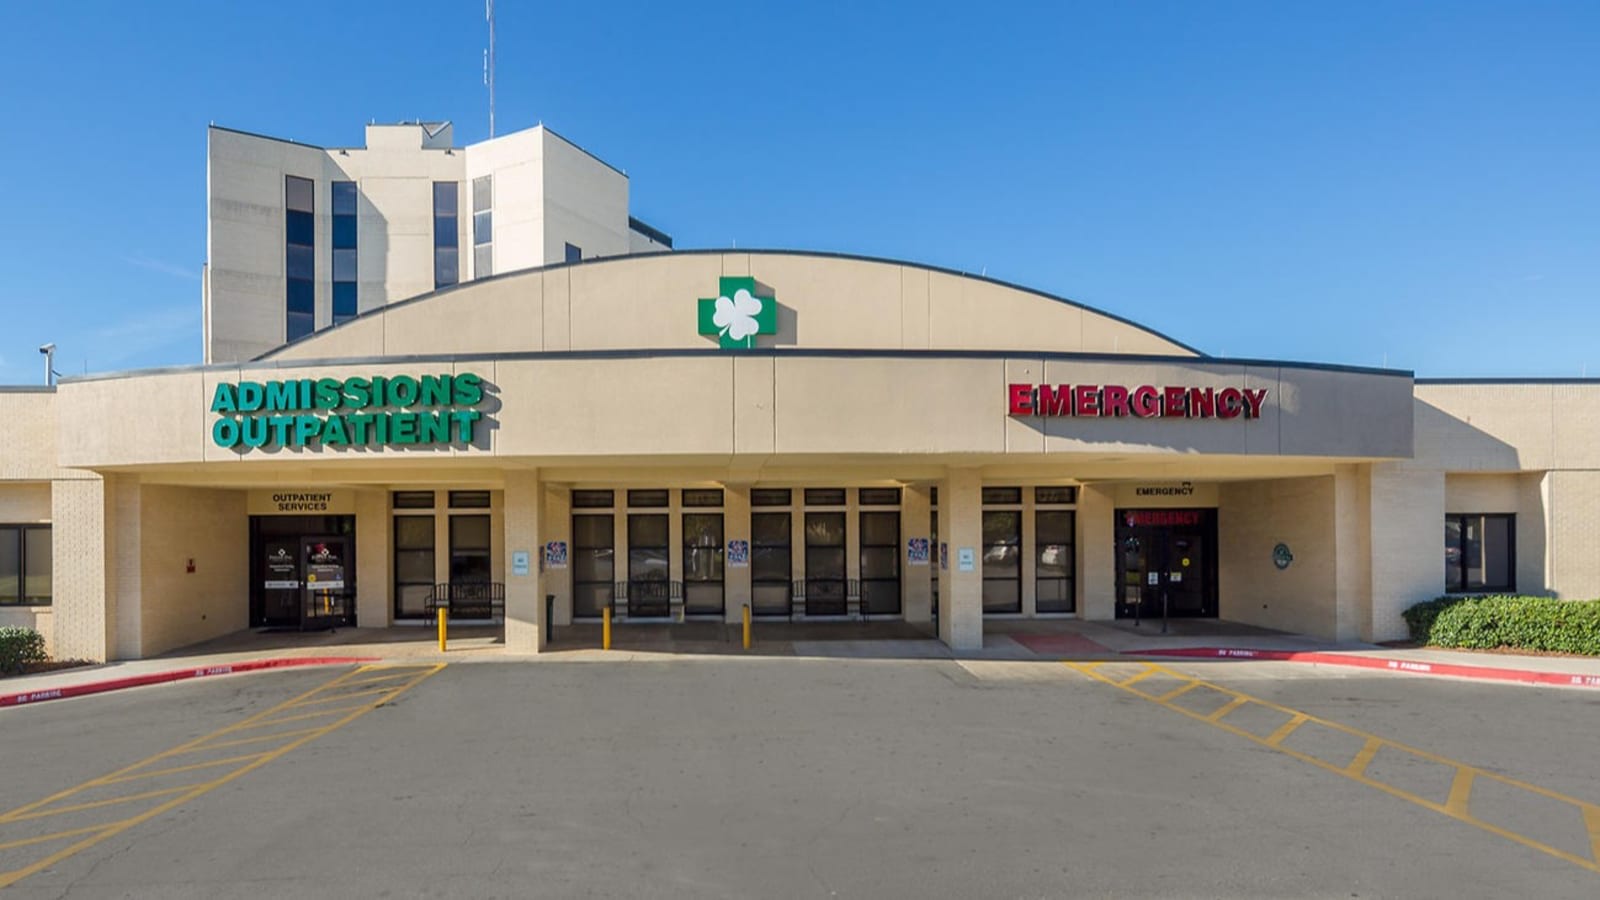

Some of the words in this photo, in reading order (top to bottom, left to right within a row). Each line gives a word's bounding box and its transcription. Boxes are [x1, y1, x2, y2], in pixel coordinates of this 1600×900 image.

[210, 373, 482, 412] ADMISSIONS
[1008, 384, 1268, 418] EMERGENCY
[212, 411, 481, 447] OUTPATIENT
[272, 493, 332, 502] OUTPATIENT
[1136, 487, 1194, 496] EMERGENCY
[278, 502, 327, 511] SERVICES
[1126, 511, 1200, 525] EMERGENCY
